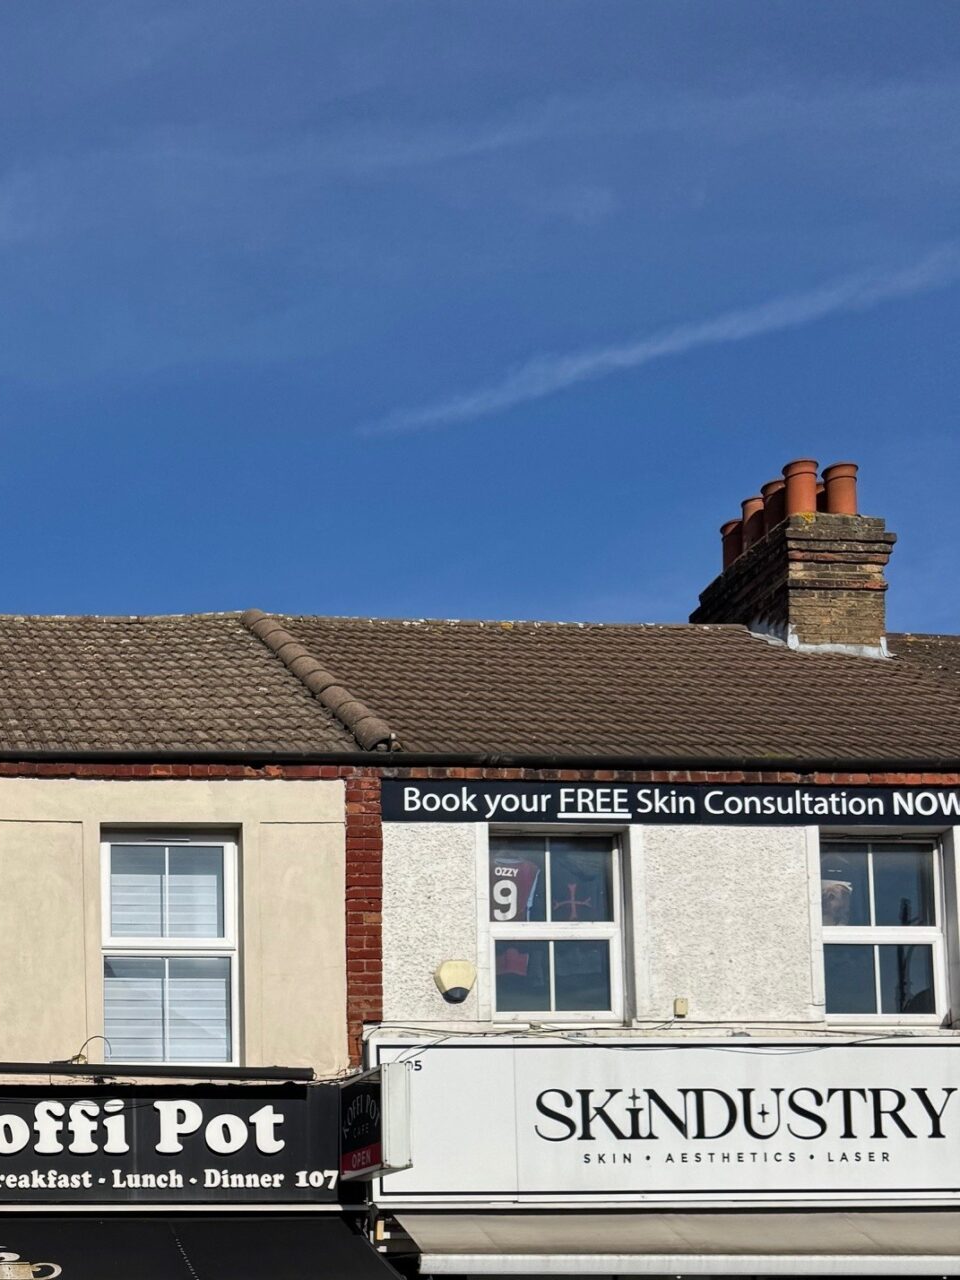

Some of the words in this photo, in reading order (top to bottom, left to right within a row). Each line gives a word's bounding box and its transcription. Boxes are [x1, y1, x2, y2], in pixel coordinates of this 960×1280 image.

[404, 787, 478, 812] Book
[484, 793, 551, 818] your
[560, 788, 629, 813] FREE
[636, 788, 695, 814] Skin
[704, 790, 884, 815] Consultation
[893, 792, 960, 815] NOW
[494, 867, 518, 877] OZZY
[493, 880, 518, 921] 9
[153, 1099, 285, 1154] Pot
[351, 1150, 371, 1169] OPEN
[584, 1153, 633, 1164] SKIN
[665, 1152, 797, 1163] AESTHETICS
[827, 1152, 890, 1162] LASER
[112, 1169, 184, 1189] Lunch
[203, 1168, 285, 1189] Dinner
[295, 1170, 339, 1190] 107
